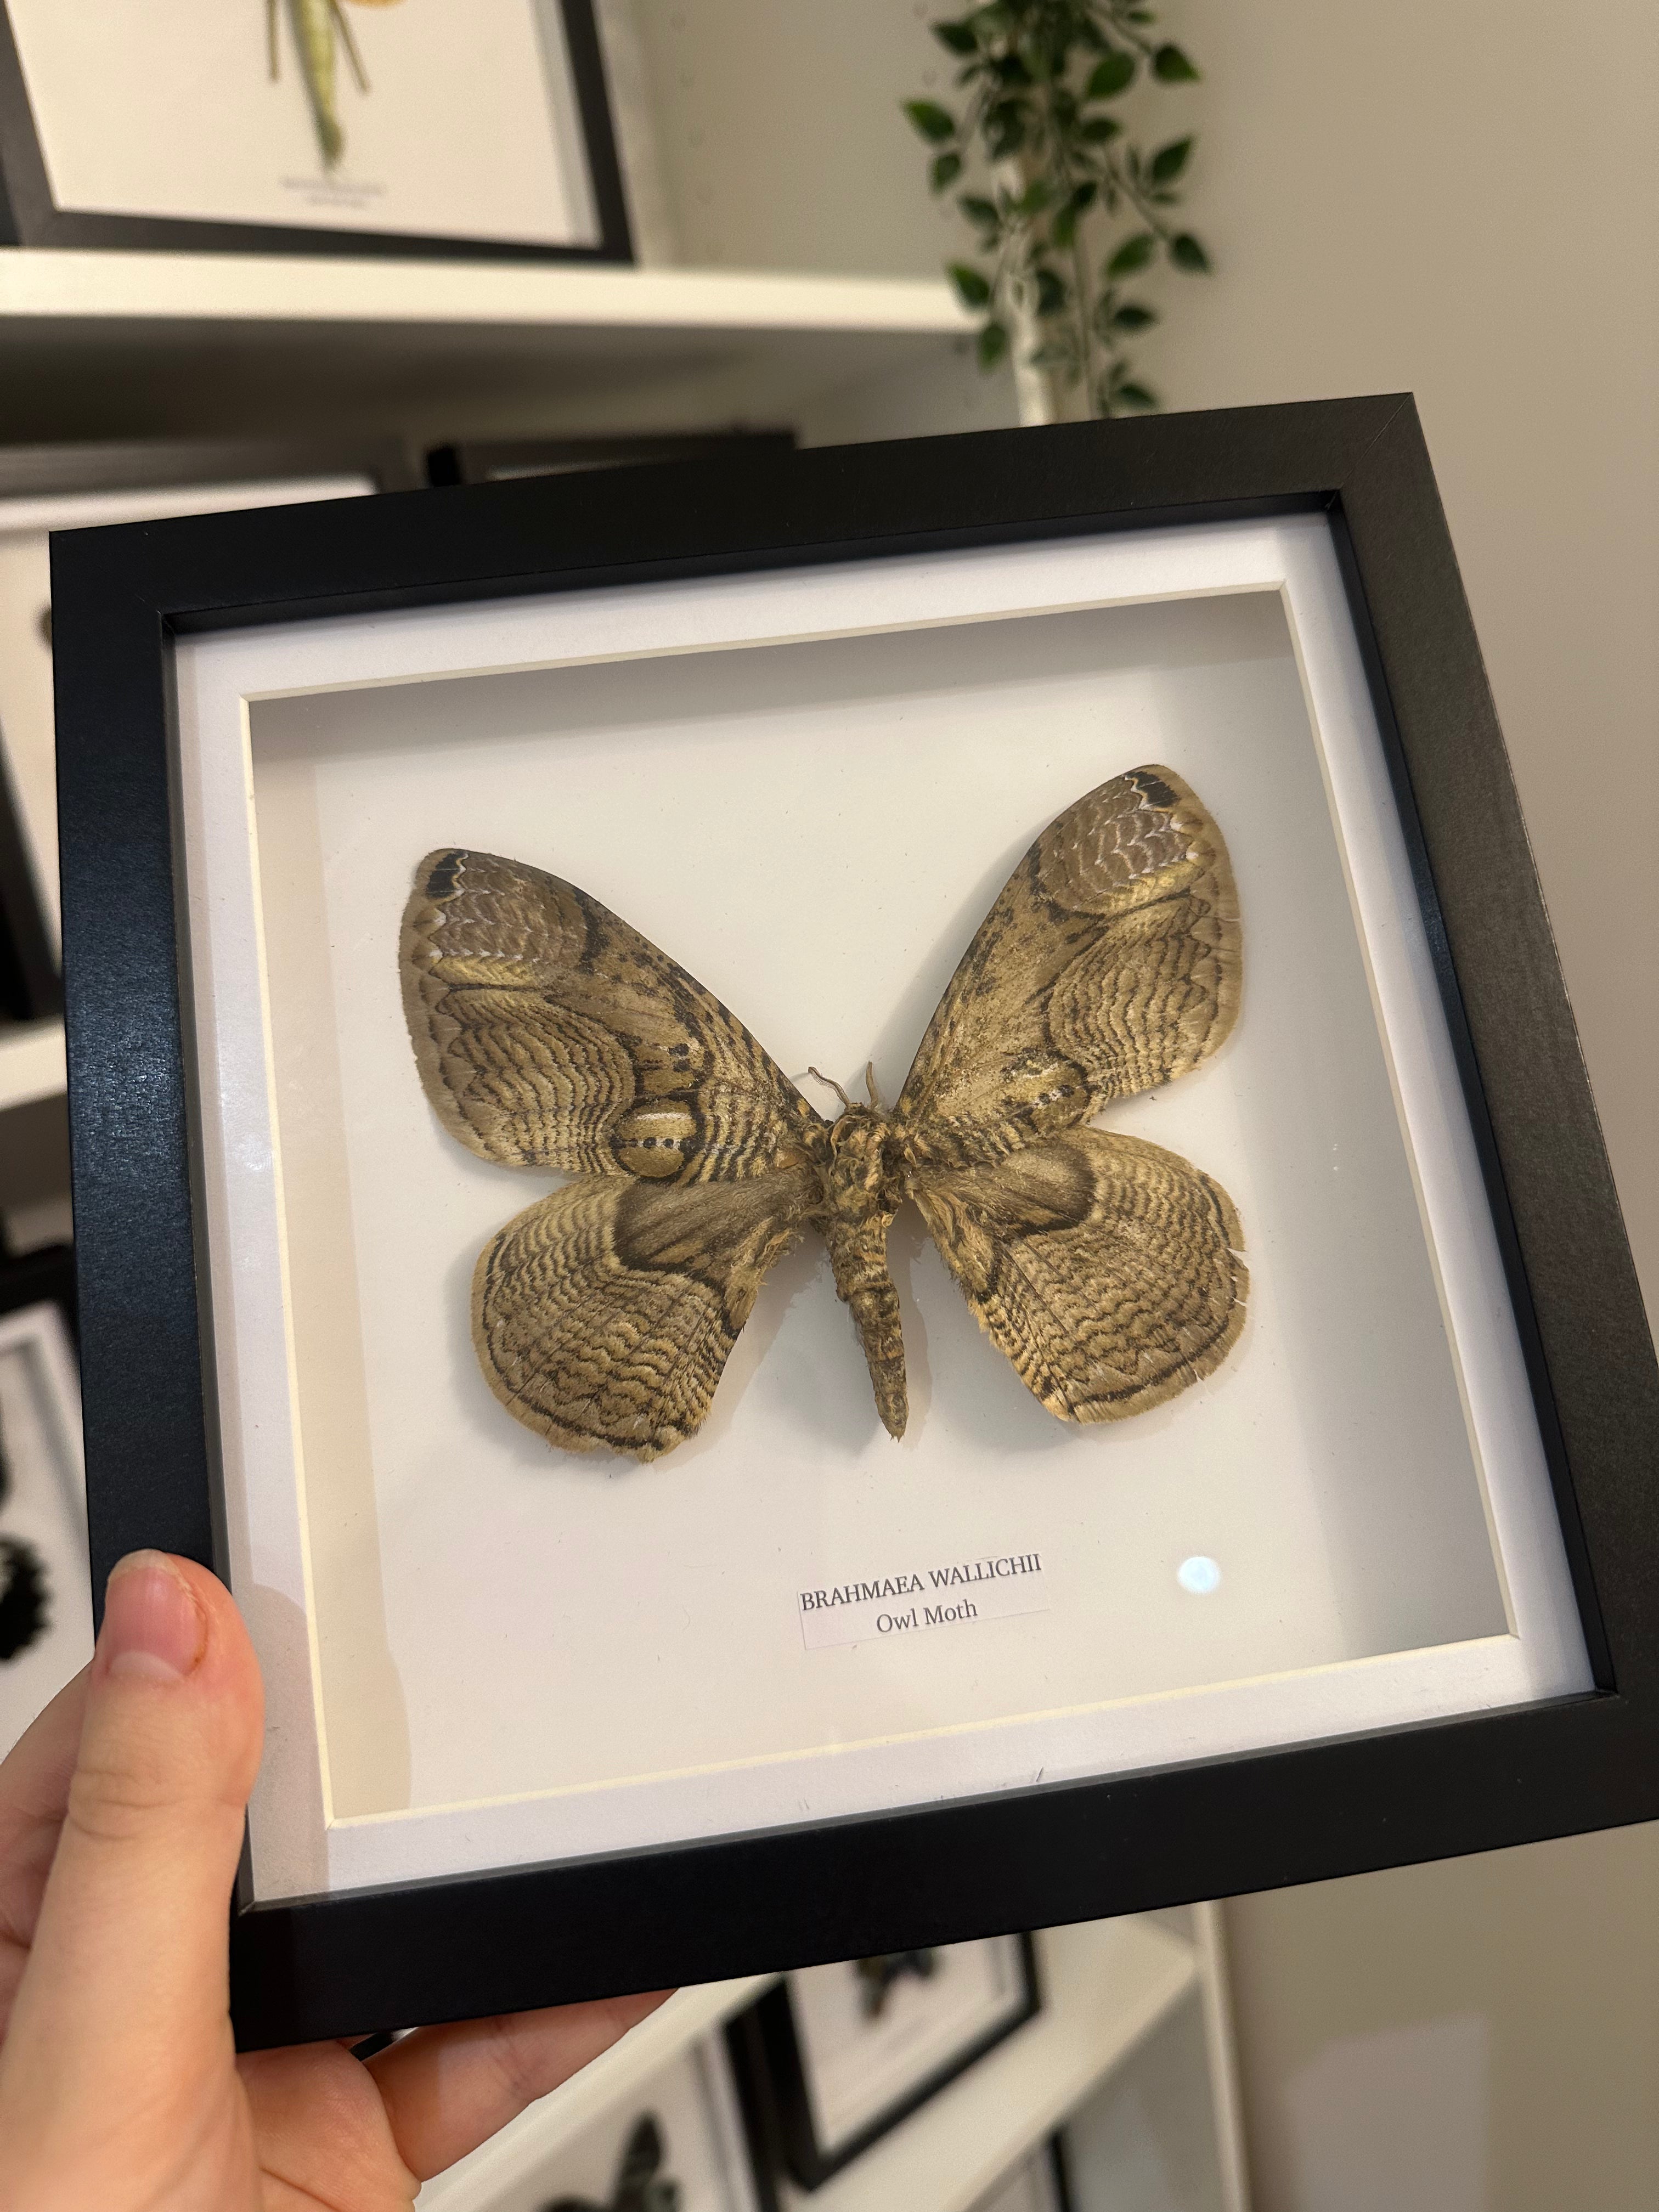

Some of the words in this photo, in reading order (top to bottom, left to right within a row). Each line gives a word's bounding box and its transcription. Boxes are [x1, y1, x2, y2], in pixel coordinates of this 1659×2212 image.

[800, 1573, 925, 1611] BRAHMAEA
[928, 1553, 1041, 1588] WALLICHII
[876, 1607, 919, 1633] Owl
[924, 1599, 978, 1625] Moth
